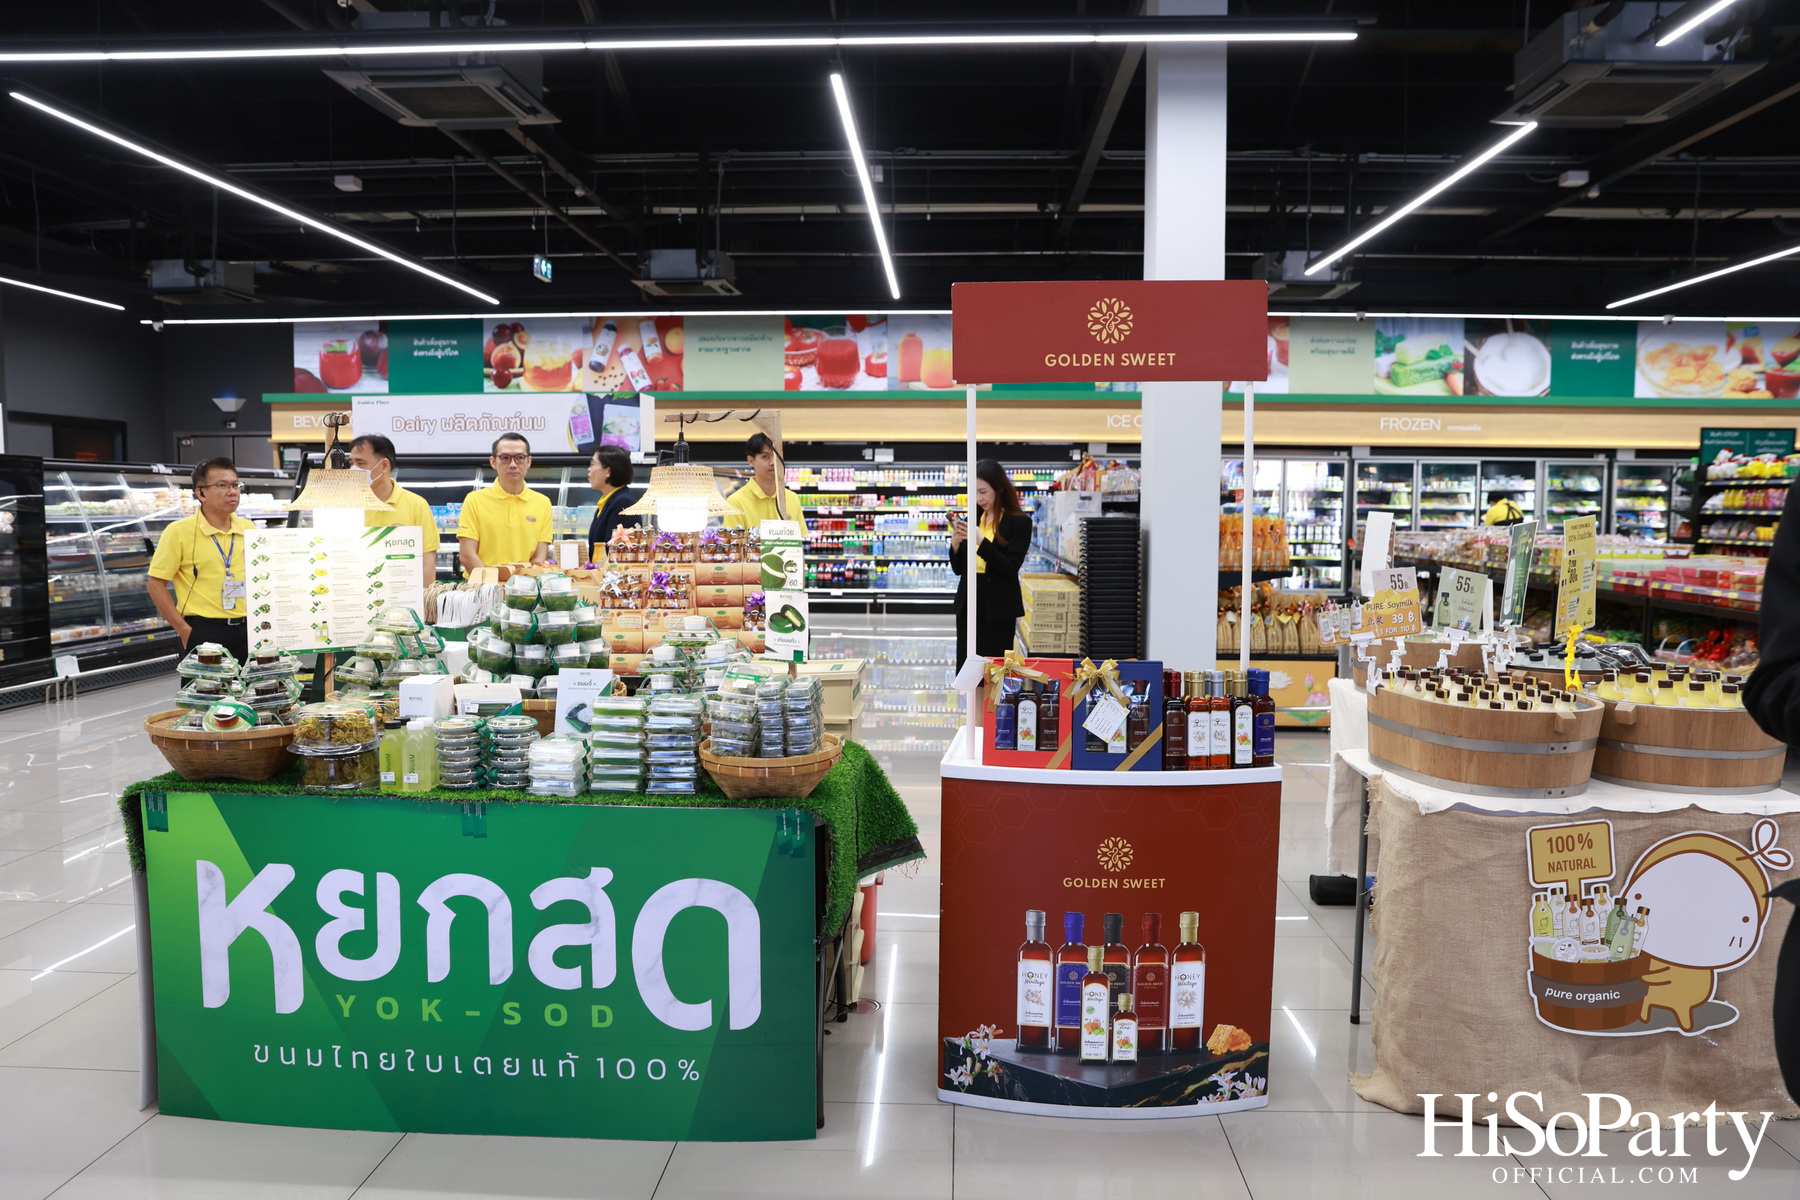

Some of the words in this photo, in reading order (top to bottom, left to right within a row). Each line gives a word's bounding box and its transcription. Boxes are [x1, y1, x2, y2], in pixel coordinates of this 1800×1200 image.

[1044, 353, 1115, 368] GOLDEN
[1120, 352, 1176, 367] SWEET
[392, 415, 437, 435] Dairy
[441, 411, 546, 432] ผลิตภัณฑ์นม
[1107, 414, 1132, 428] ICE
[1380, 417, 1441, 431] FROZEN
[384, 539, 415, 549] หยกสด
[1366, 603, 1384, 611] PURE
[1387, 599, 1414, 610] Soymilk
[1392, 613, 1404, 624] 39
[1546, 832, 1594, 854] 100%
[1547, 857, 1597, 874] NATURAL
[1063, 877, 1118, 889] GOLDEN
[1122, 877, 1165, 889] SWEET
[195, 858, 762, 1032] หยกสด
[1022, 971, 1048, 979] HONEY
[1175, 973, 1201, 981] HONEY
[1545, 986, 1573, 1000] pure
[1575, 989, 1621, 1004] organic
[332, 994, 616, 1029] YOK-SOD
[253, 1043, 581, 1080] ขนมไทยใบเตยแท้
[595, 1055, 701, 1082] 100%
